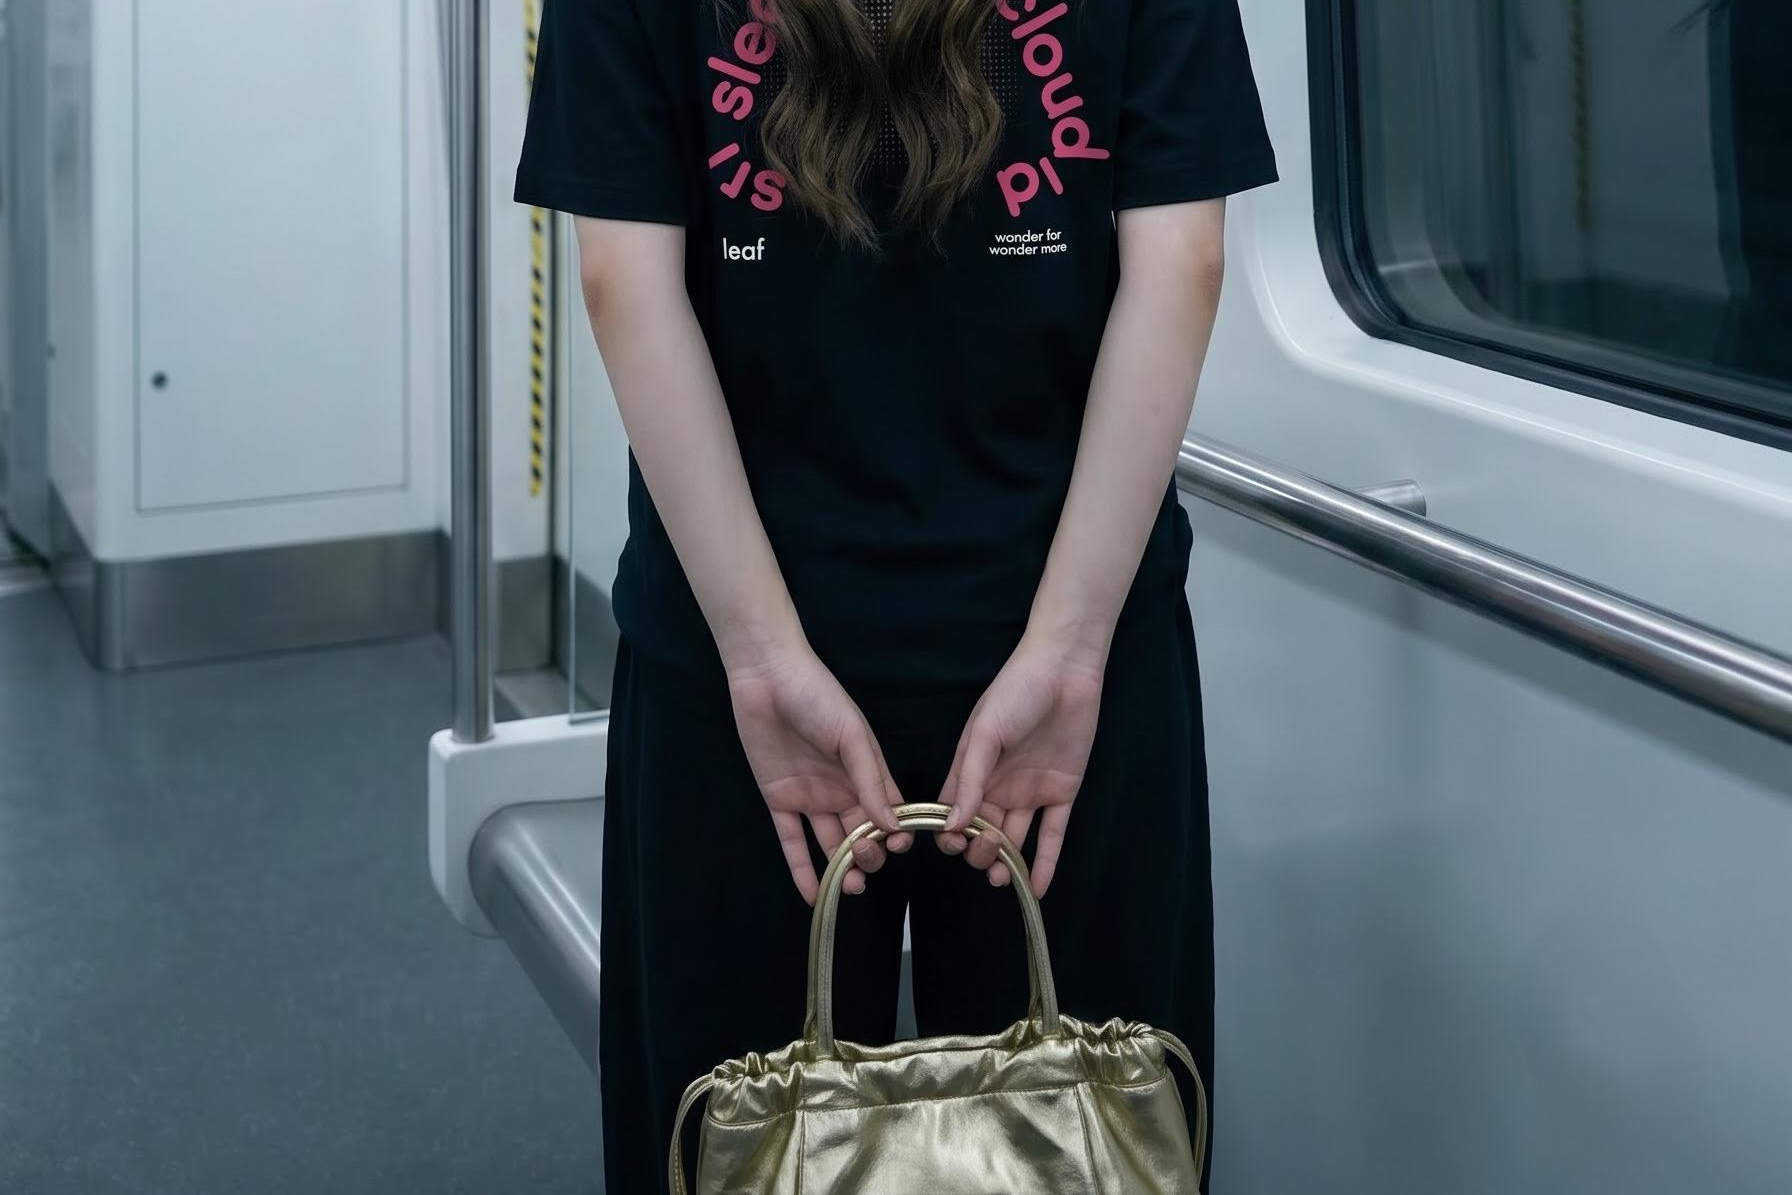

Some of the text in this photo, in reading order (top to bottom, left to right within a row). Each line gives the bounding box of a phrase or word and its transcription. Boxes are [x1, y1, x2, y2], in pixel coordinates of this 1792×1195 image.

[994, 228, 1061, 243] wonder for
[722, 237, 765, 261] leaf
[988, 243, 1067, 255] wonder more
